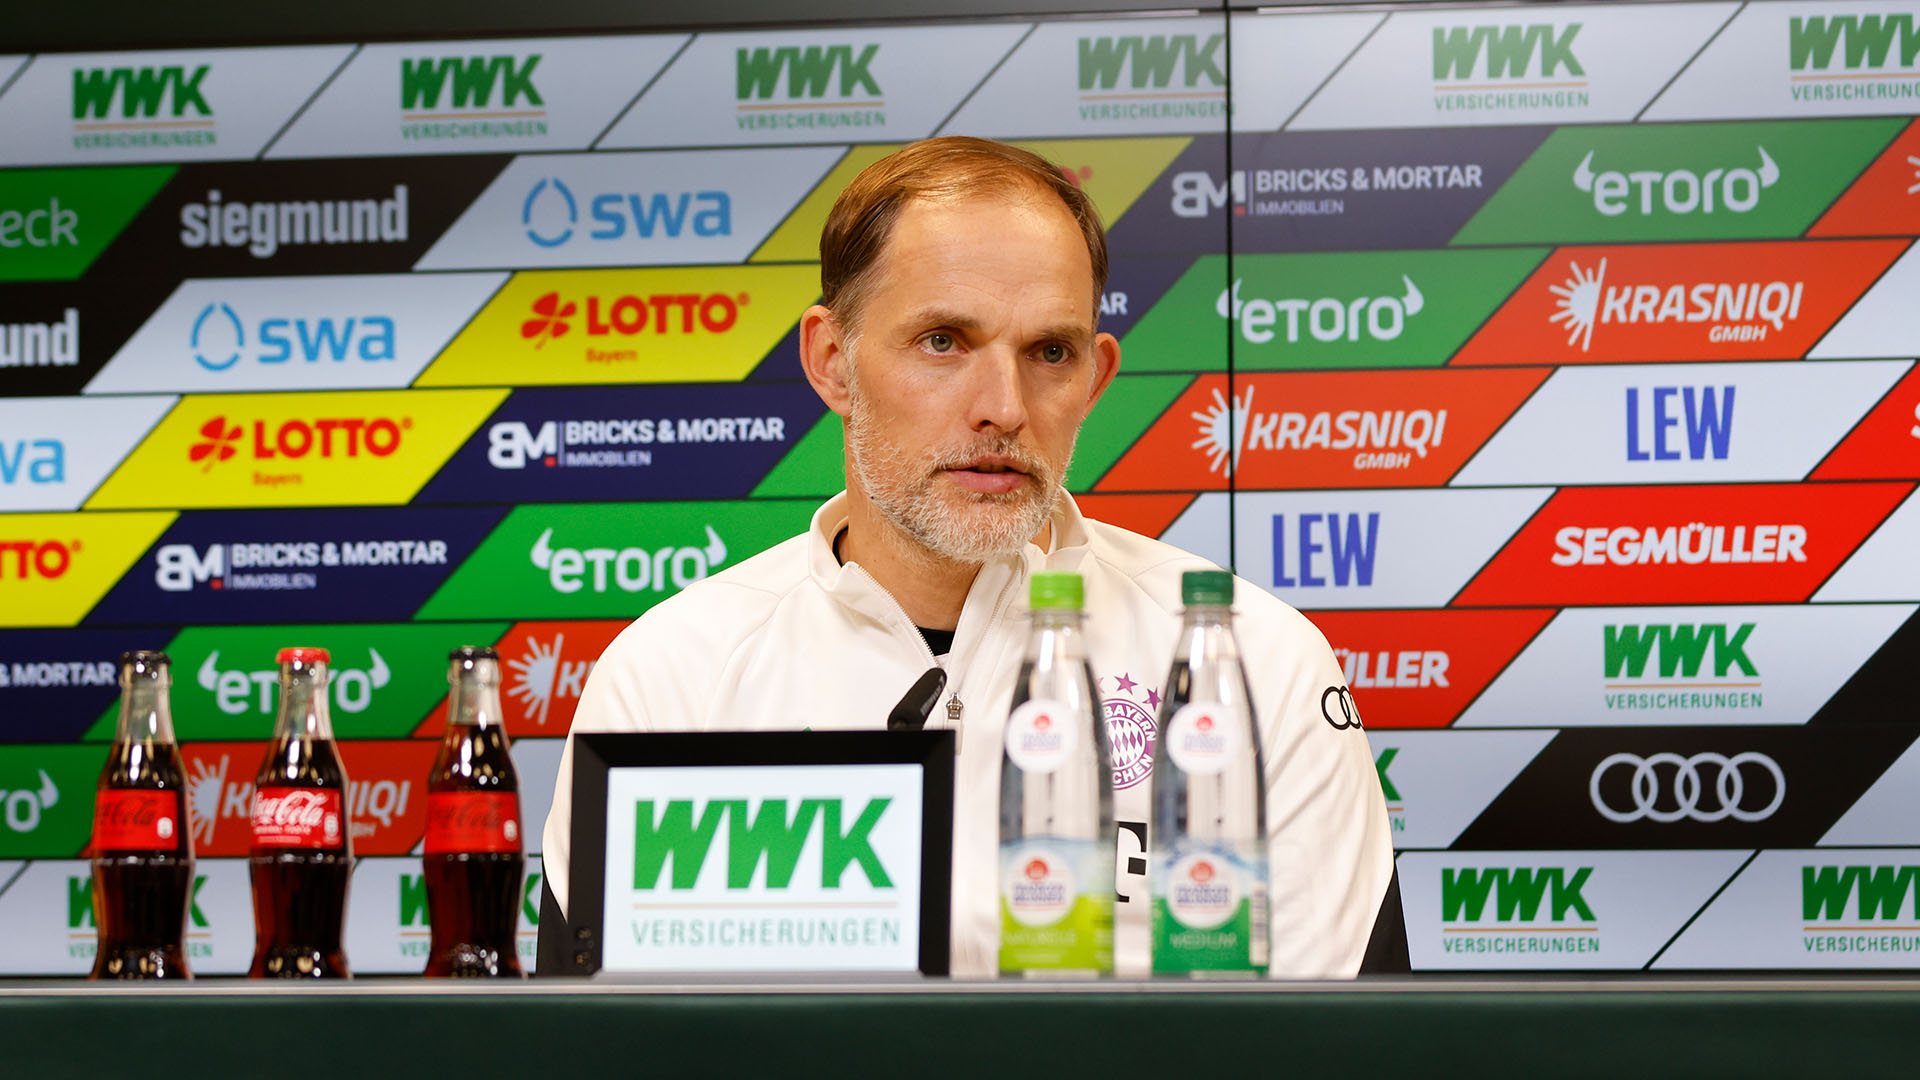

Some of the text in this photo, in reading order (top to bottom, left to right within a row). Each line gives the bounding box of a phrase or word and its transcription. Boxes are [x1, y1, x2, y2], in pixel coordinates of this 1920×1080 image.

[1077, 33, 1226, 91] WWK
[1431, 22, 1587, 81] WWK
[401, 54, 546, 111] WWK
[735, 43, 883, 100] WWK
[73, 65, 213, 120] WWK
[1432, 91, 1590, 111] VERSICHERUNGEN
[401, 119, 548, 140] VERSICHERUNGEN
[736, 110, 887, 131] VERSICHERUNGEN
[72, 129, 218, 150] VERSICHERUNGEN
[1255, 164, 1483, 193] BRICKS & MORTAR
[180, 185, 409, 259] siegmund
[589, 190, 733, 240] swa
[1255, 199, 1345, 216] IMMOBILIEN
[1601, 281, 1805, 331] KRASNIQI
[257, 315, 396, 364] swa
[1708, 325, 1767, 343] GMBH
[584, 347, 639, 364] Bayern
[564, 416, 785, 445] BRICKS & MORTAR
[1247, 409, 1448, 458] KRASNIQI
[1626, 384, 1737, 463] LEW
[565, 450, 652, 467] IMMOBILIEN
[1353, 452, 1411, 470] GMBH
[252, 471, 304, 488] Bayern
[231, 541, 448, 567] BRICKS & MORTAR
[1271, 512, 1381, 588] LEW
[1550, 521, 1809, 567] SEGMÜLLER
[1602, 622, 1761, 679] WWK
[11, 661, 117, 687] MORTAR
[1603, 691, 1763, 710] VERSICHERUNGEN
[632, 796, 896, 891] WWK
[1440, 866, 1598, 922] WWK
[1801, 865, 1920, 921] WW
[631, 918, 900, 947] VERSICHERUNGEN
[1442, 934, 1601, 953] VERSICHERUNGEN
